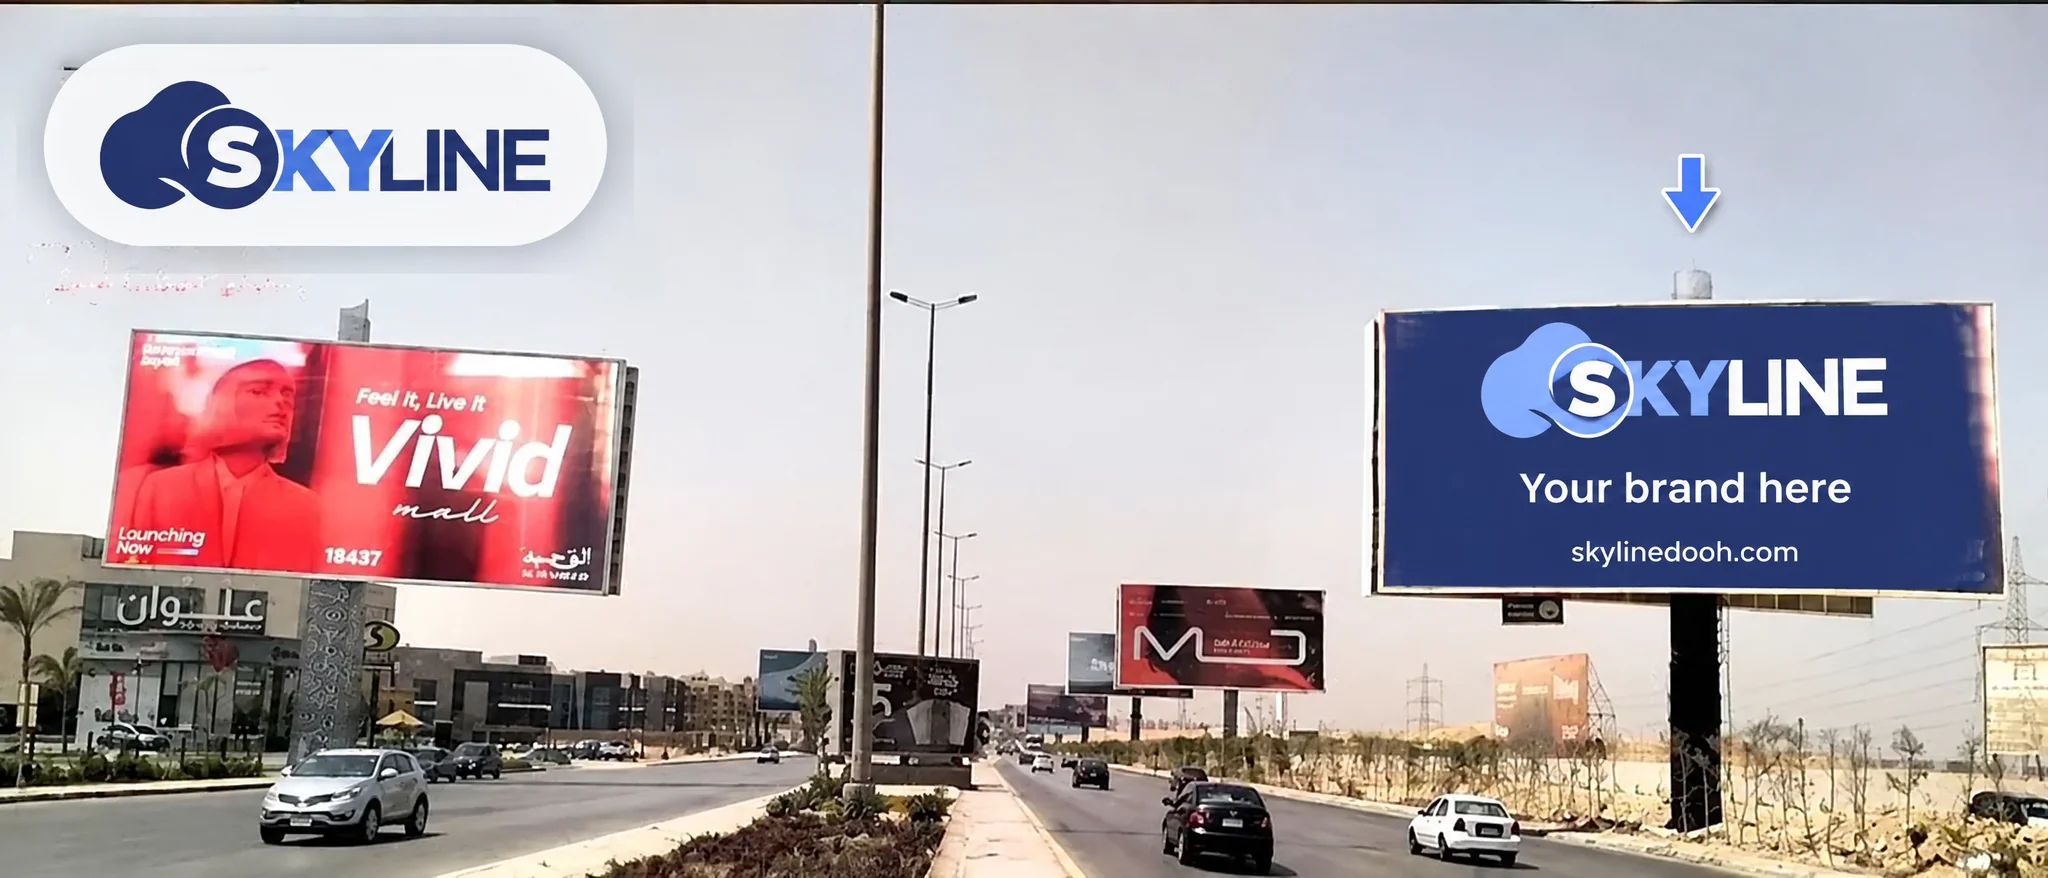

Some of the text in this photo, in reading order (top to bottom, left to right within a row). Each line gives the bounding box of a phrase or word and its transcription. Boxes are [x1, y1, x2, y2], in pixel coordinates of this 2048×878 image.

[357, 387, 486, 412] Feel It, Live It
[1568, 358, 1887, 417] SKYLINE
[353, 414, 573, 497] Vivid
[1521, 472, 1852, 504] Your brand here
[391, 498, 499, 525] mall
[115, 540, 154, 555] Now
[118, 526, 206, 548] Launching
[324, 548, 382, 566] 18437
[1571, 541, 1798, 567] skylinedooh.com
